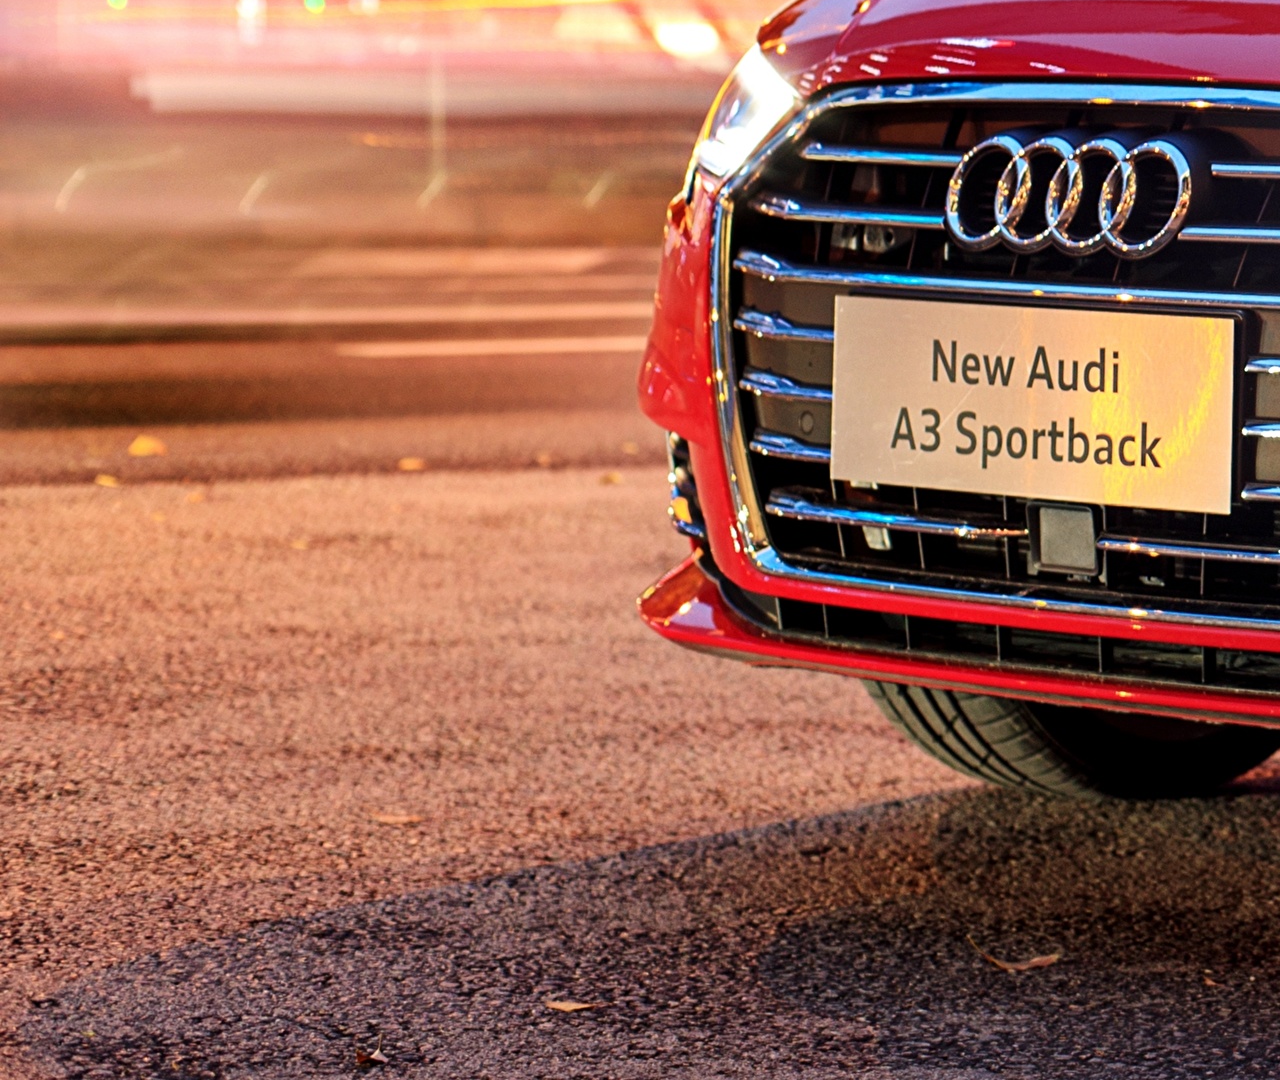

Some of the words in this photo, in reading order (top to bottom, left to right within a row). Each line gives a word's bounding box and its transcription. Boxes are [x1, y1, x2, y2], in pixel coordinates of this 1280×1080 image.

[931, 339, 1015, 387] New
[1027, 345, 1120, 393] Audi
[890, 406, 941, 452] A3
[955, 410, 1162, 469] Sportback
